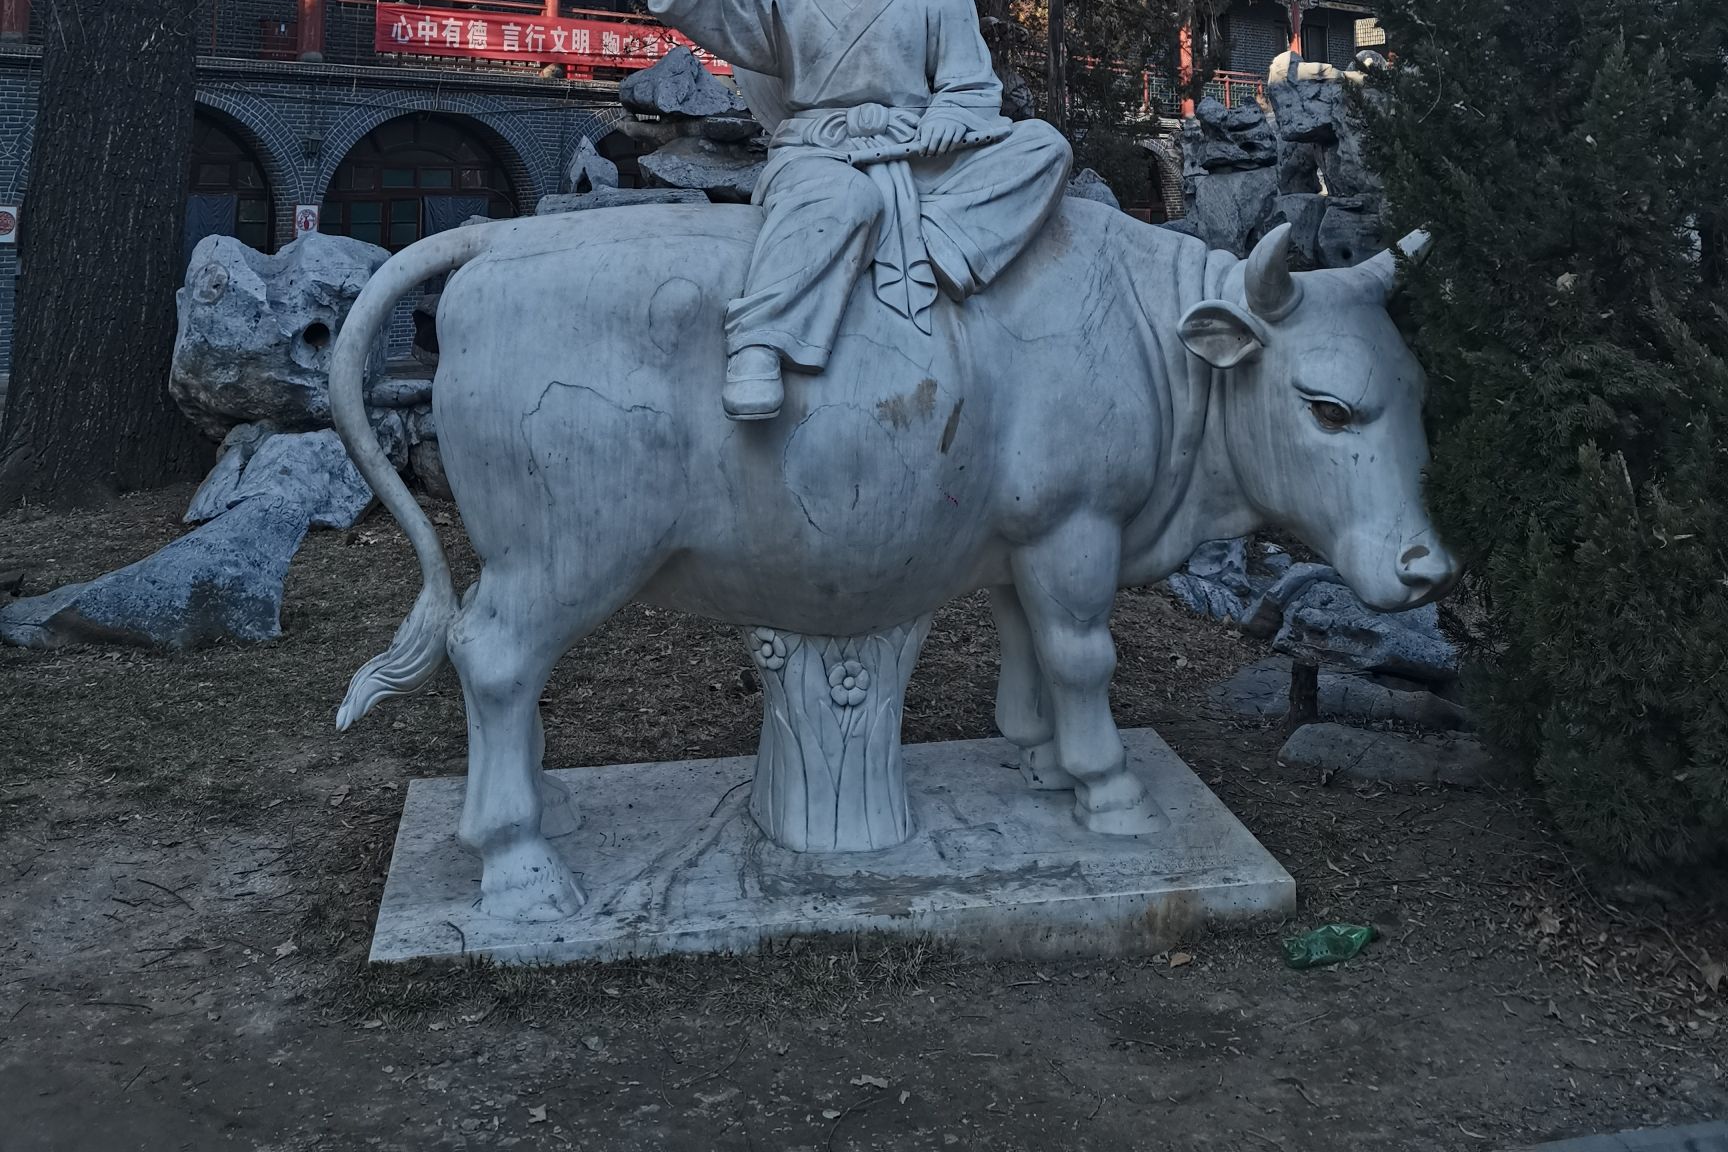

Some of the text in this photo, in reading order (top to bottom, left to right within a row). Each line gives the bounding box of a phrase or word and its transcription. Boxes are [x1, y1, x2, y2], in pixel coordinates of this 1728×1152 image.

[391, 15, 488, 50] 心中有德
[501, 22, 590, 55] 言行文明
